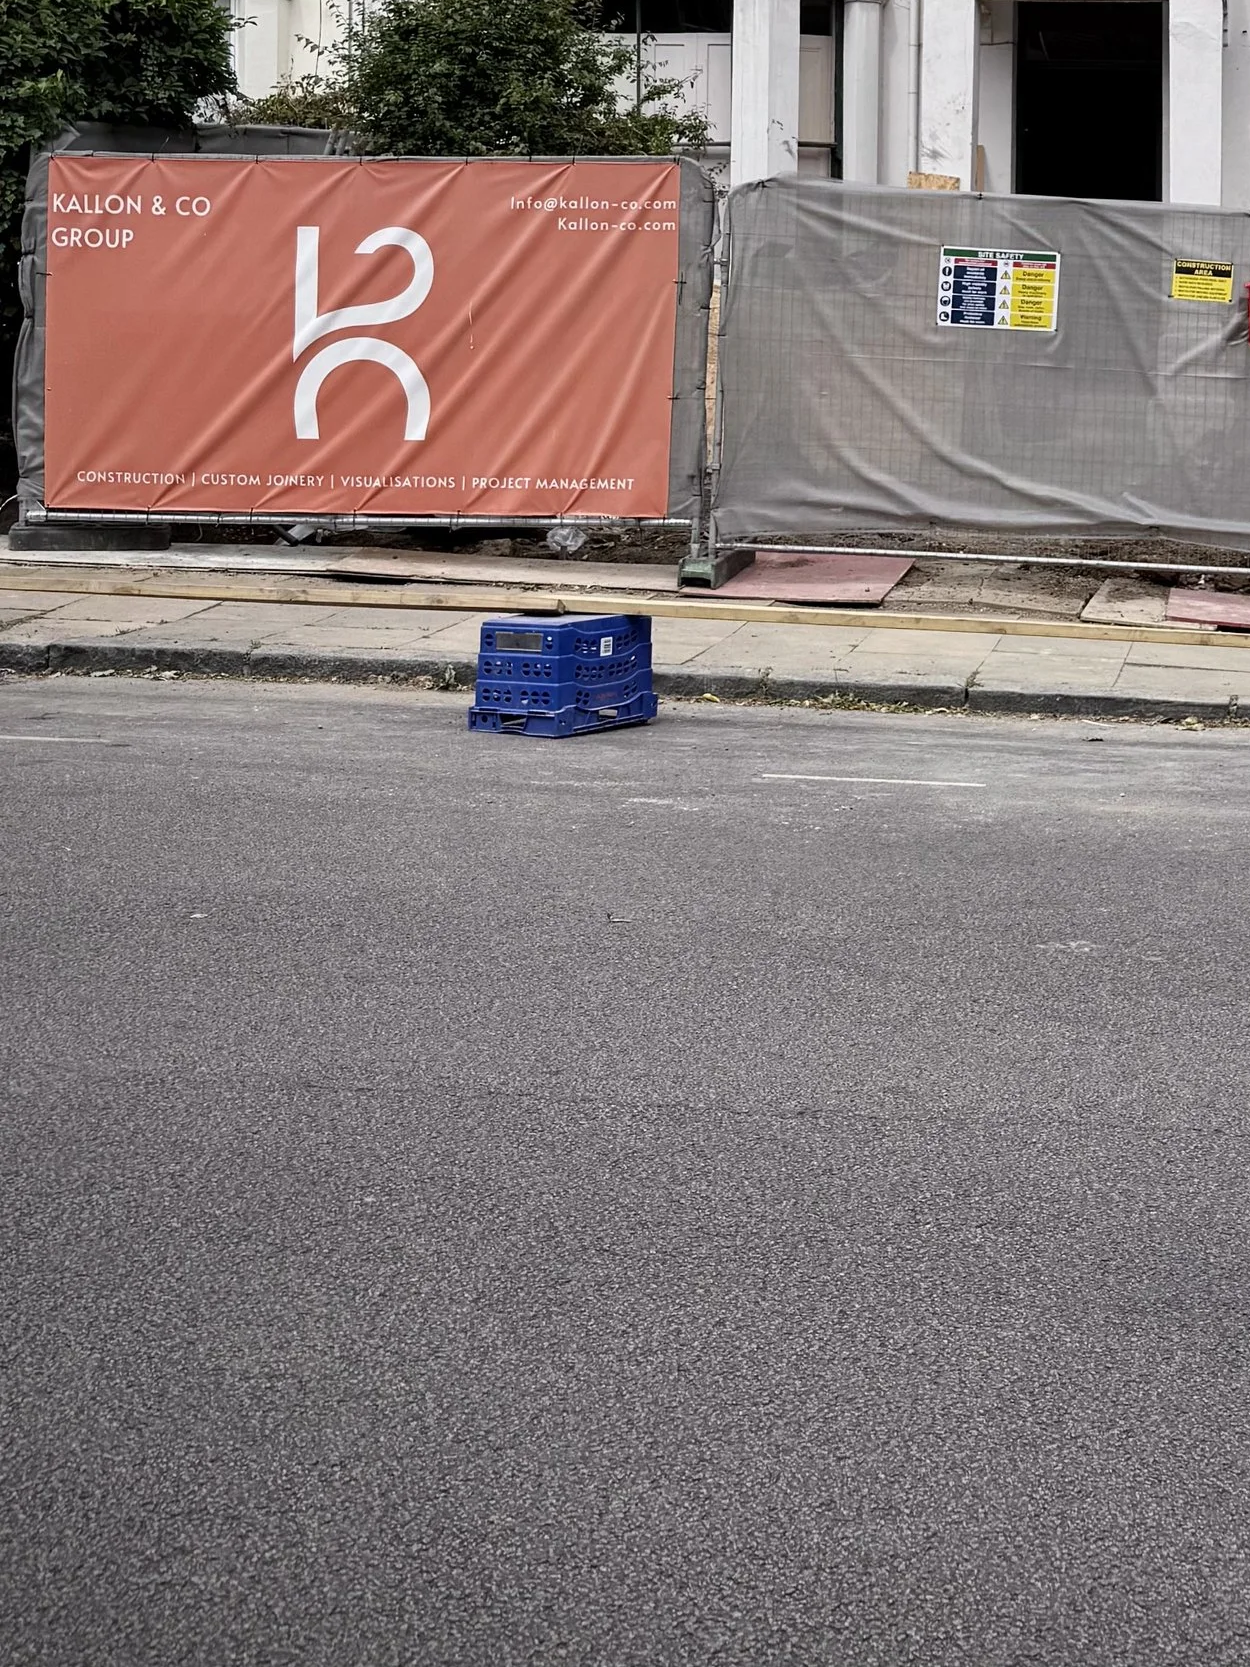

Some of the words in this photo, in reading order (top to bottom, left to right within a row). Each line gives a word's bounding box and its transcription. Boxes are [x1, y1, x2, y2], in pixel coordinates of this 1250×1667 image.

[53, 193, 142, 215] KALLON
[151, 195, 166, 215] &
[175, 196, 211, 216] CO
[510, 196, 677, 211] Info@kallon-co.com
[558, 217, 676, 231] Kallon-co.com
[51, 227, 134, 248] GROUP
[978, 251, 994, 259] SITE
[995, 252, 1025, 260] SAFETY
[1177, 261, 1231, 271] CONSTRUCTION
[77, 470, 185, 485] CONSTRUCTION
[201, 473, 260, 486] CUSTOM
[266, 474, 324, 487] JOINERY
[341, 475, 456, 489] VISUALISATIONS
[472, 477, 531, 490] PROJECT
[535, 478, 634, 491] MANAGEMENT
